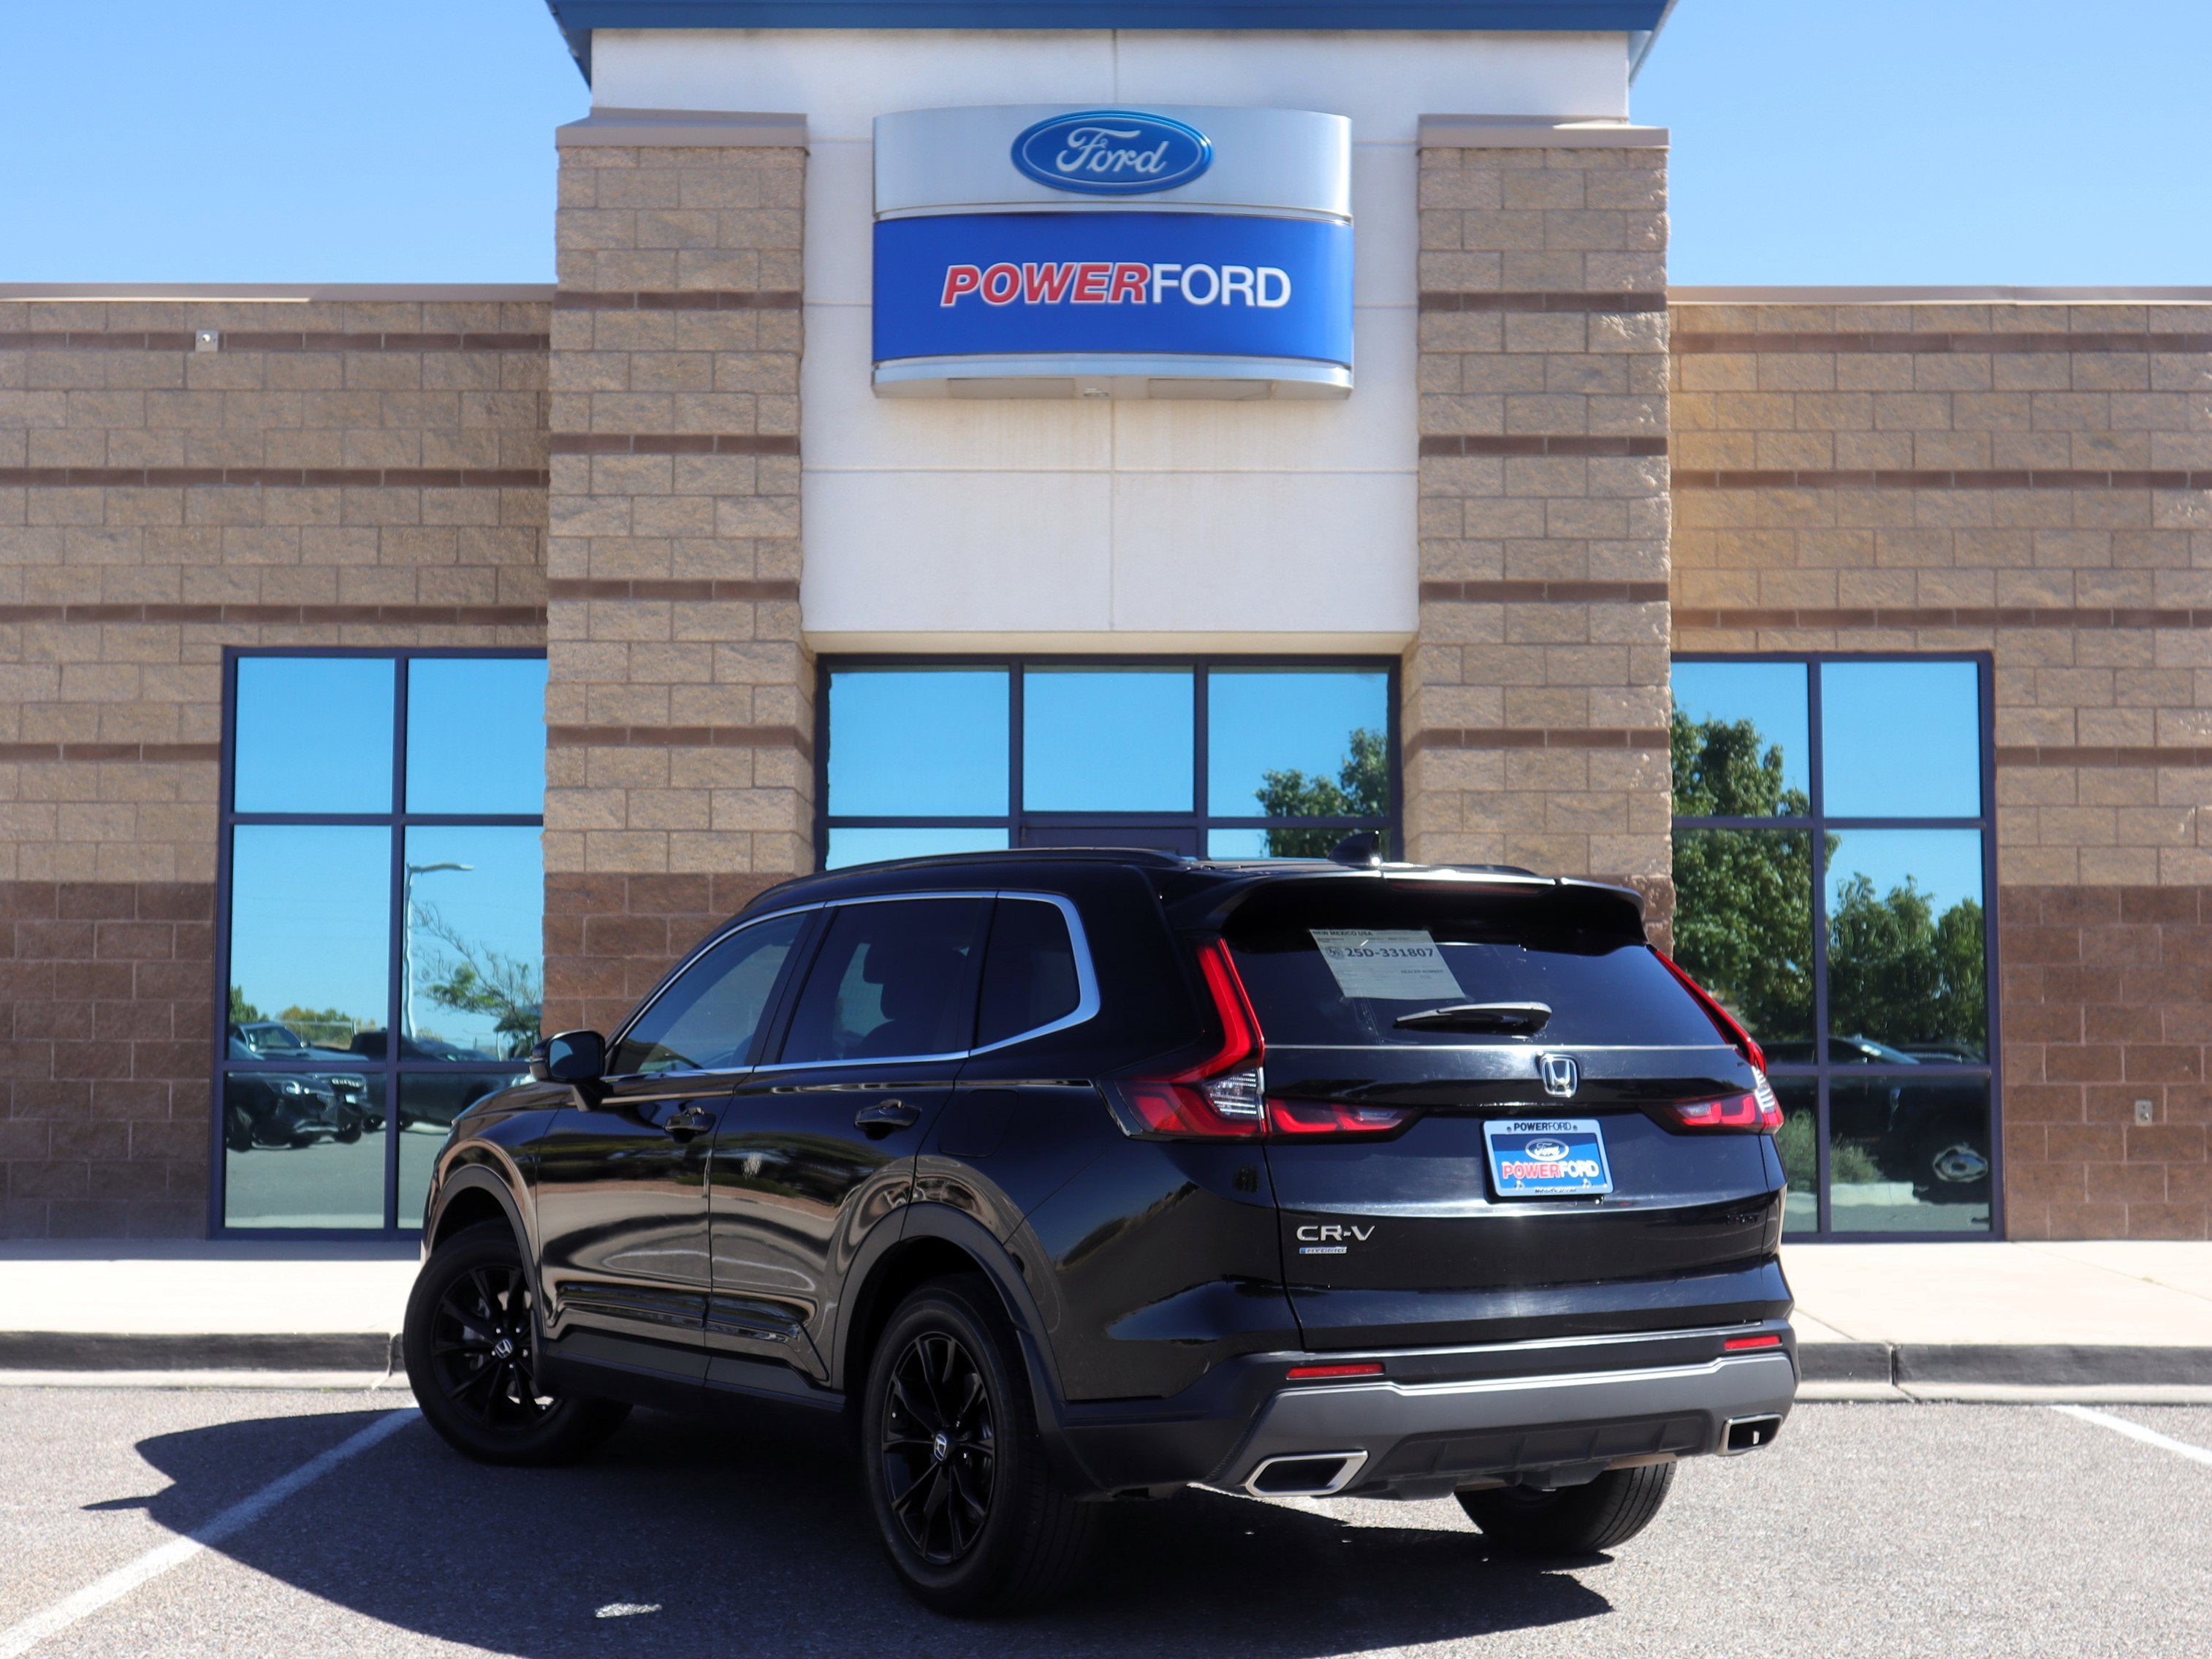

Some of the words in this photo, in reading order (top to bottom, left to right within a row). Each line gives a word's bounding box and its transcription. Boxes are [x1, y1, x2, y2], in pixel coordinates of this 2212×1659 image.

[1056, 126, 1169, 175] Ford
[940, 260, 1292, 308] POWERFORD
[1345, 947, 1434, 957] 25D-331807
[1513, 1122, 1572, 1131] POWERFORD
[1501, 1160, 1599, 1180] POWERFORD
[1296, 1225, 1375, 1241] CR-V
